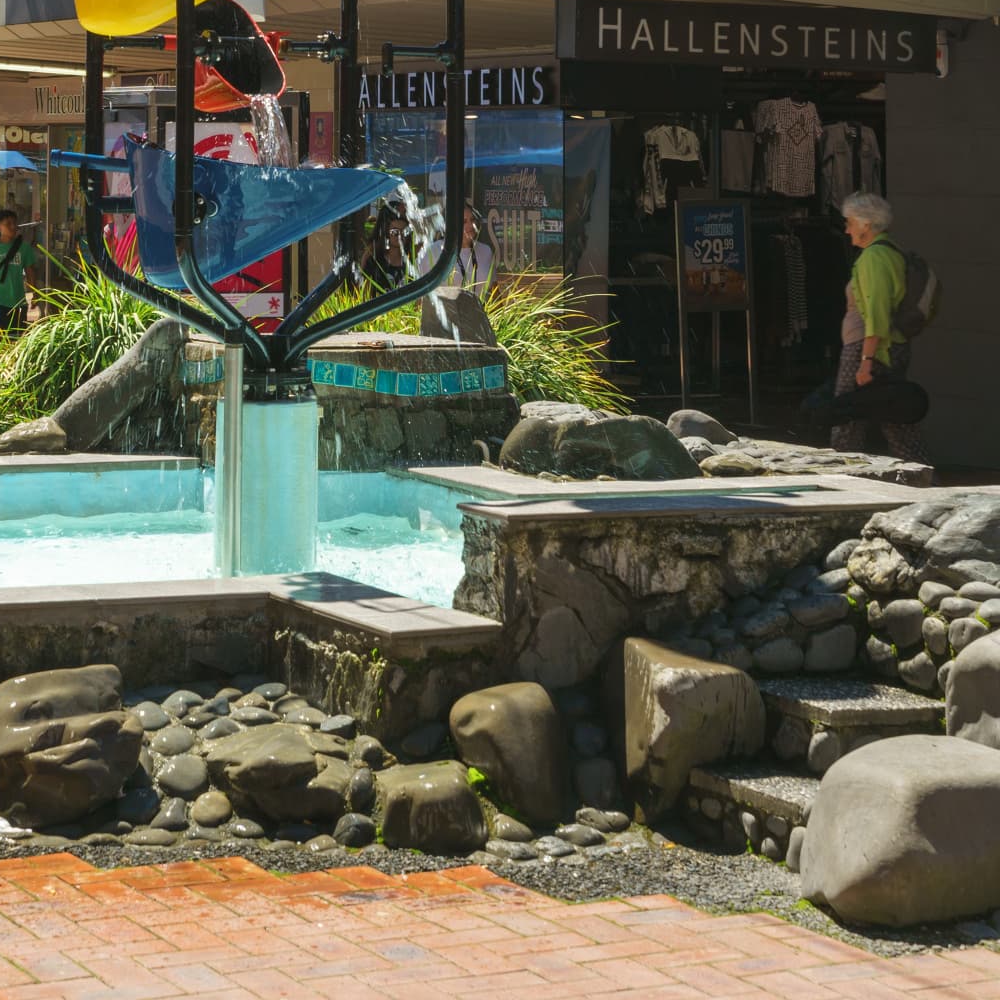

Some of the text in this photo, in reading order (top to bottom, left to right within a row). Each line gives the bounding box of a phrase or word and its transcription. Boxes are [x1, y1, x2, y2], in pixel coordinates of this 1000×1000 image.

[598, 7, 914, 62] HALLENSTEINS
[35, 86, 85, 114] Whitcoul
[358, 66, 544, 109] ALLENTEINS
[487, 208, 541, 271] SUIT
